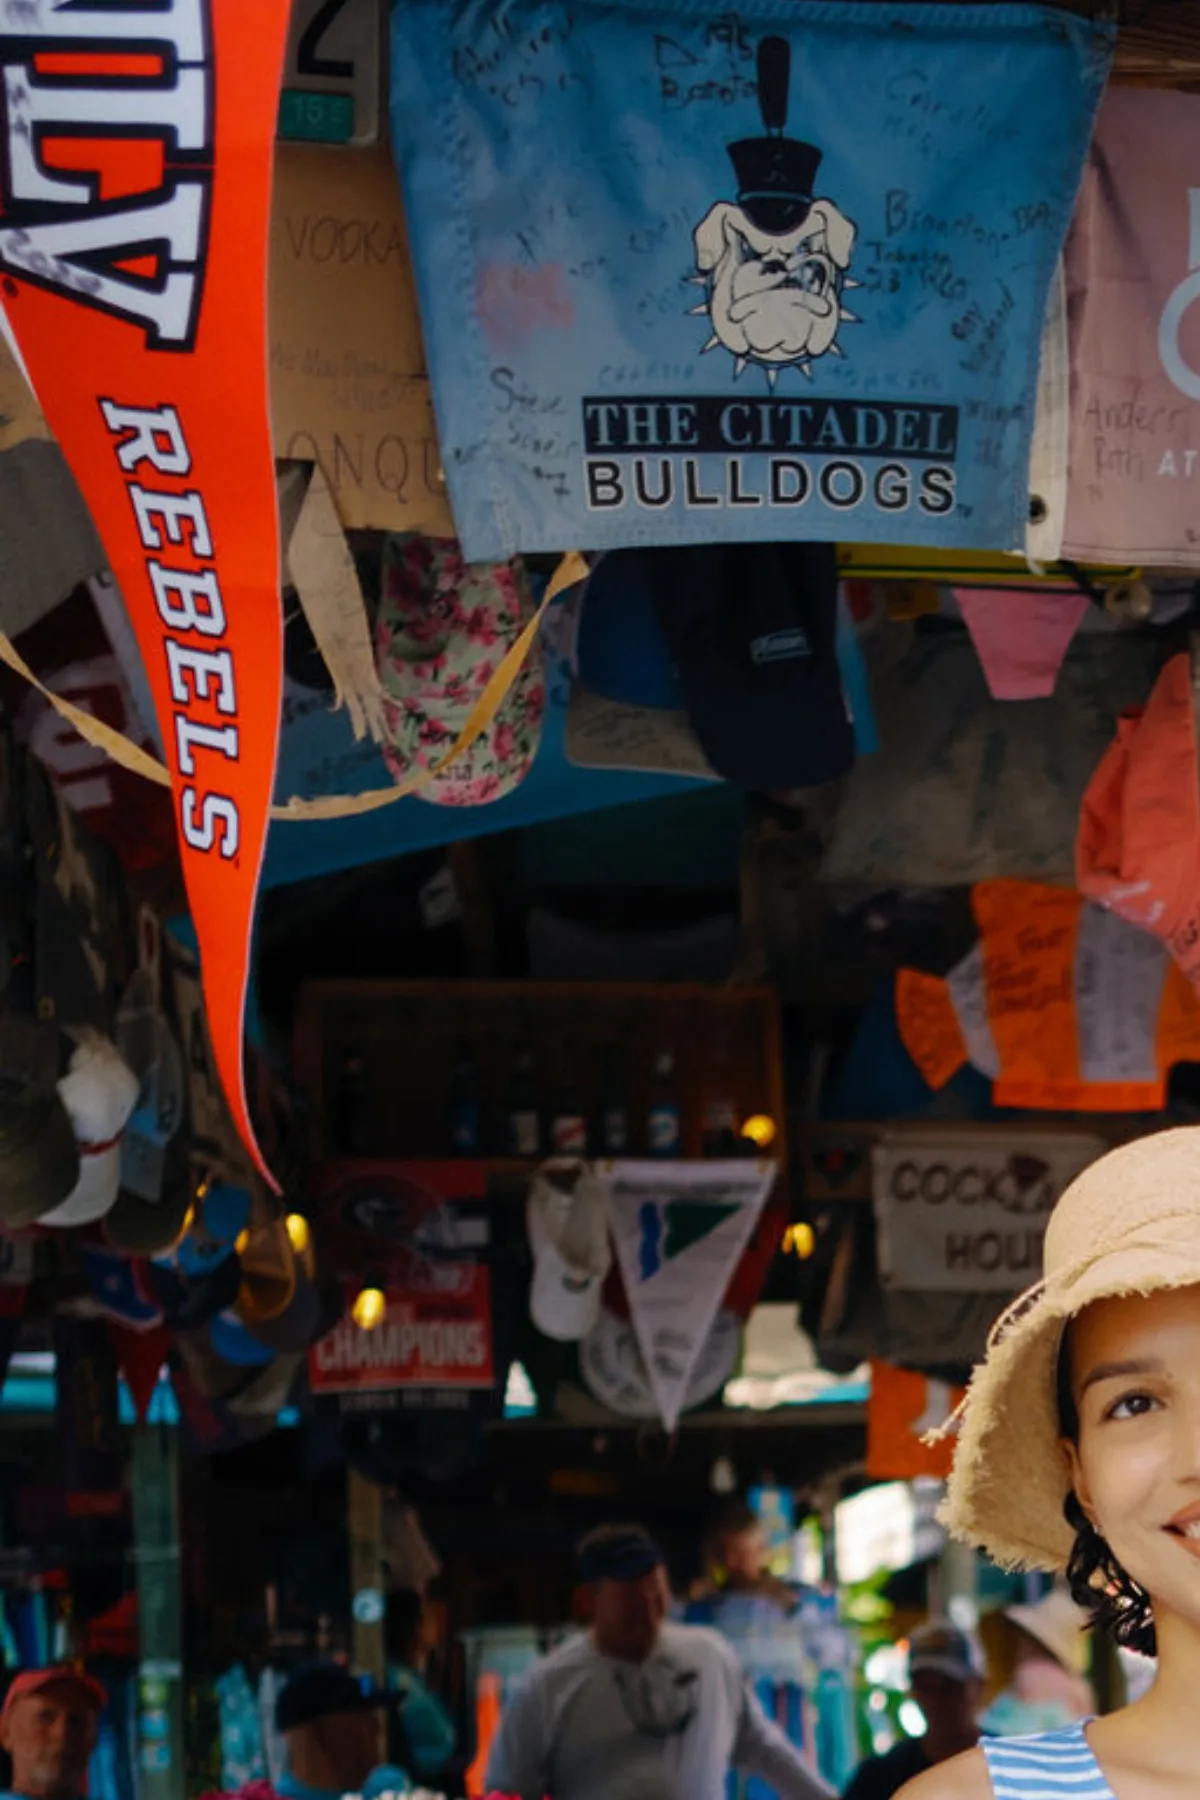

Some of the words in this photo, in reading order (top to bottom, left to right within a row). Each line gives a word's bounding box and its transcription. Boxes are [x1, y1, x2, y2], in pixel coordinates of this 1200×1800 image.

[585, 403, 698, 447] THE
[719, 403, 955, 455] CITADEL
[585, 456, 956, 515] BULLDOGS
[98, 396, 242, 860] REBELS
[314, 1320, 488, 1374] CHAMPIONS
